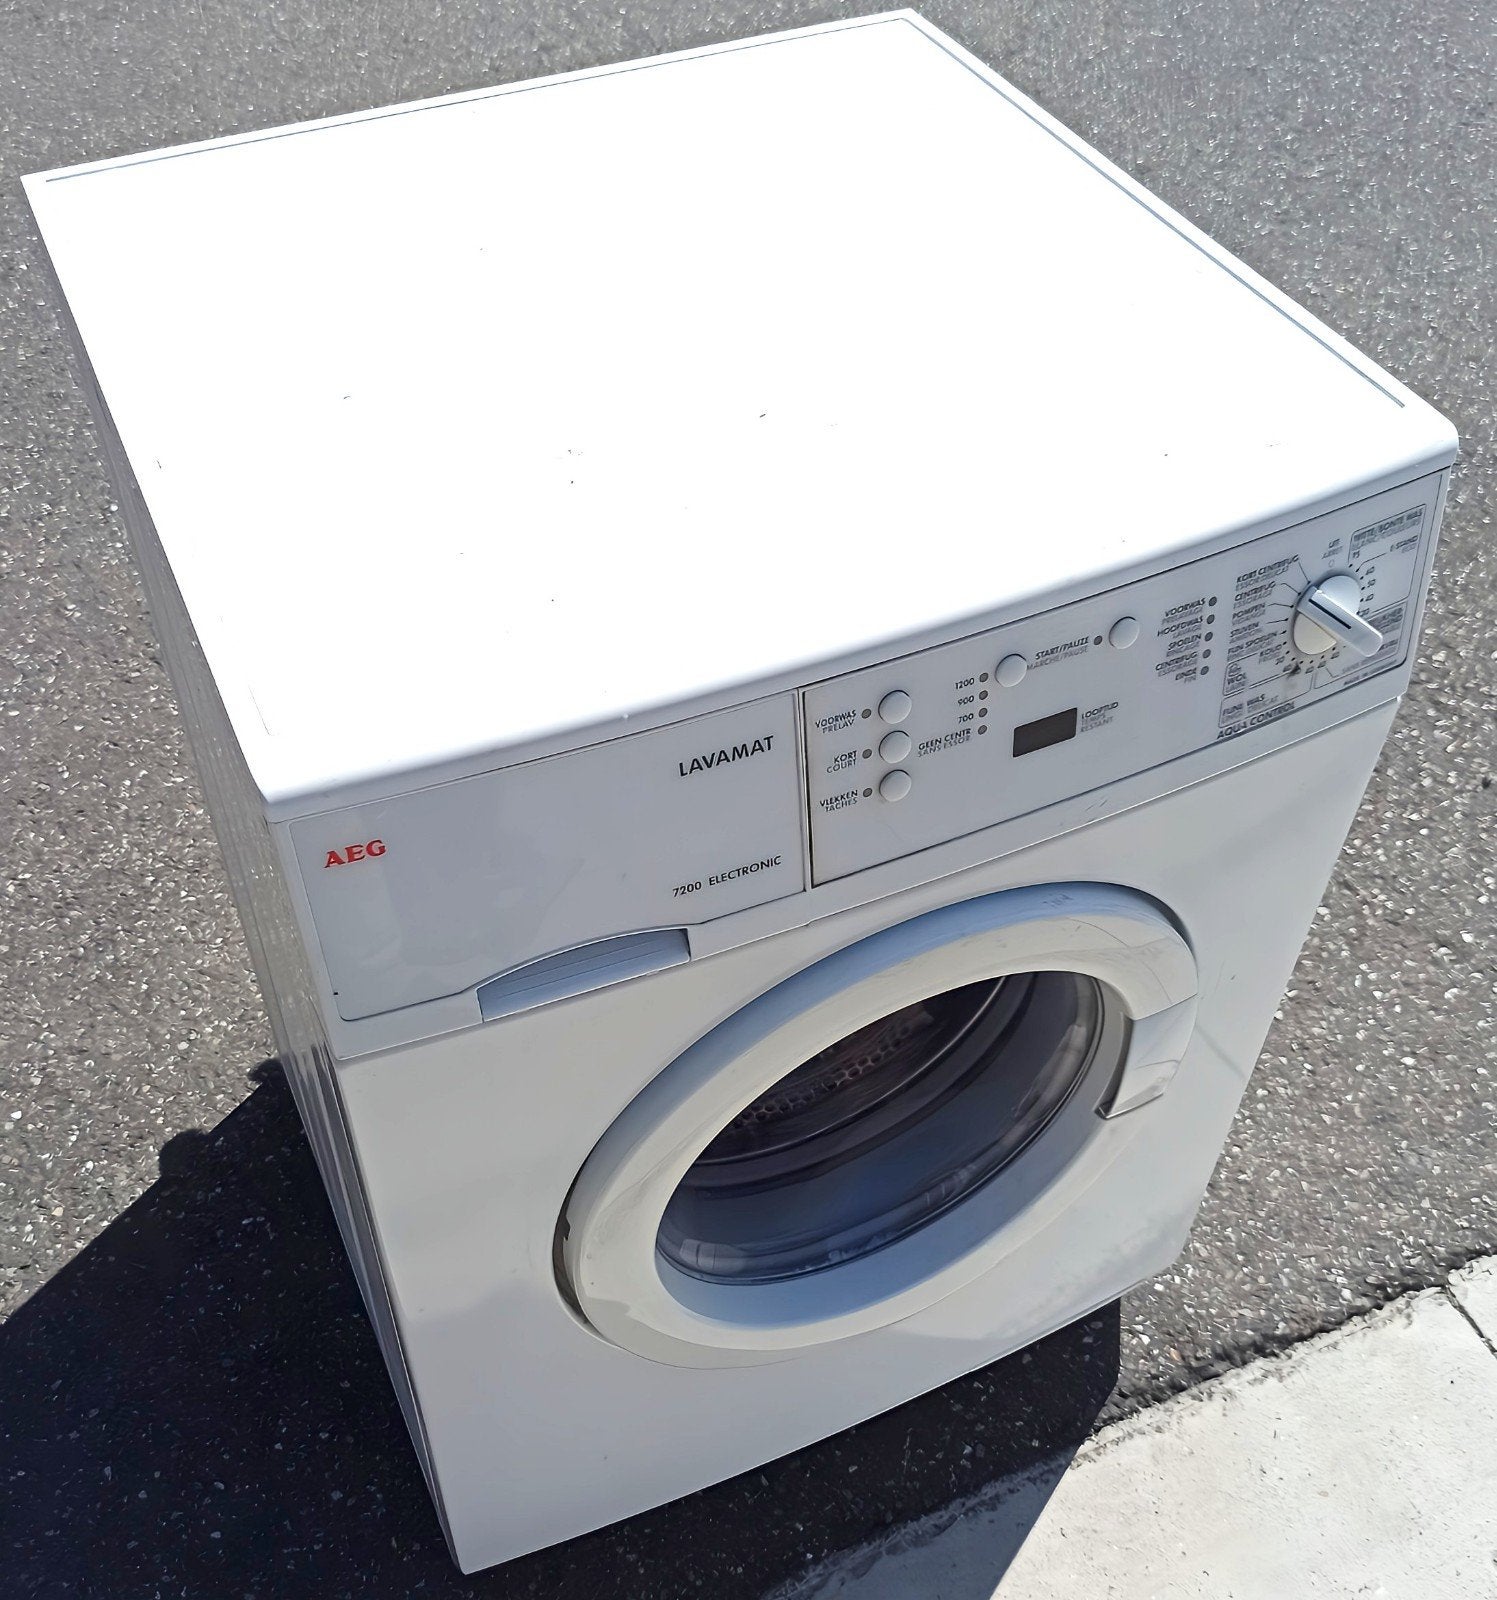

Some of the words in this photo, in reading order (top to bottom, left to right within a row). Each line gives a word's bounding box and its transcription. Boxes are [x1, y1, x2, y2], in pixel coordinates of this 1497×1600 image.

[1164, 597, 1206, 617] VOORWAS
[1157, 615, 1203, 637] HOOFDWAS
[1034, 636, 1090, 660] START/PAUZE
[1167, 633, 1202, 650] SPOELEN
[1155, 651, 1198, 671] CENTRIFUG
[955, 677, 975, 690] 1200
[957, 695, 975, 706] 900
[815, 709, 857, 729] VOORWAS
[822, 719, 855, 734] PRELAV
[958, 713, 974, 724] 700
[1216, 722, 1247, 740] AQUA
[1249, 701, 1296, 727] CONTROL
[917, 744, 942, 758] SANS
[943, 735, 971, 749] ESSOR
[918, 737, 942, 751] GEEN
[944, 728, 972, 742] CENTR
[678, 735, 775, 778] LAVAMAT
[826, 759, 857, 774] COURT
[833, 750, 858, 764] KORT
[819, 789, 858, 807] VLEKKEN
[825, 796, 858, 813] TACHES
[324, 838, 388, 869] AEG
[672, 880, 702, 898] 7200
[708, 854, 783, 887] ELECTRONIC
